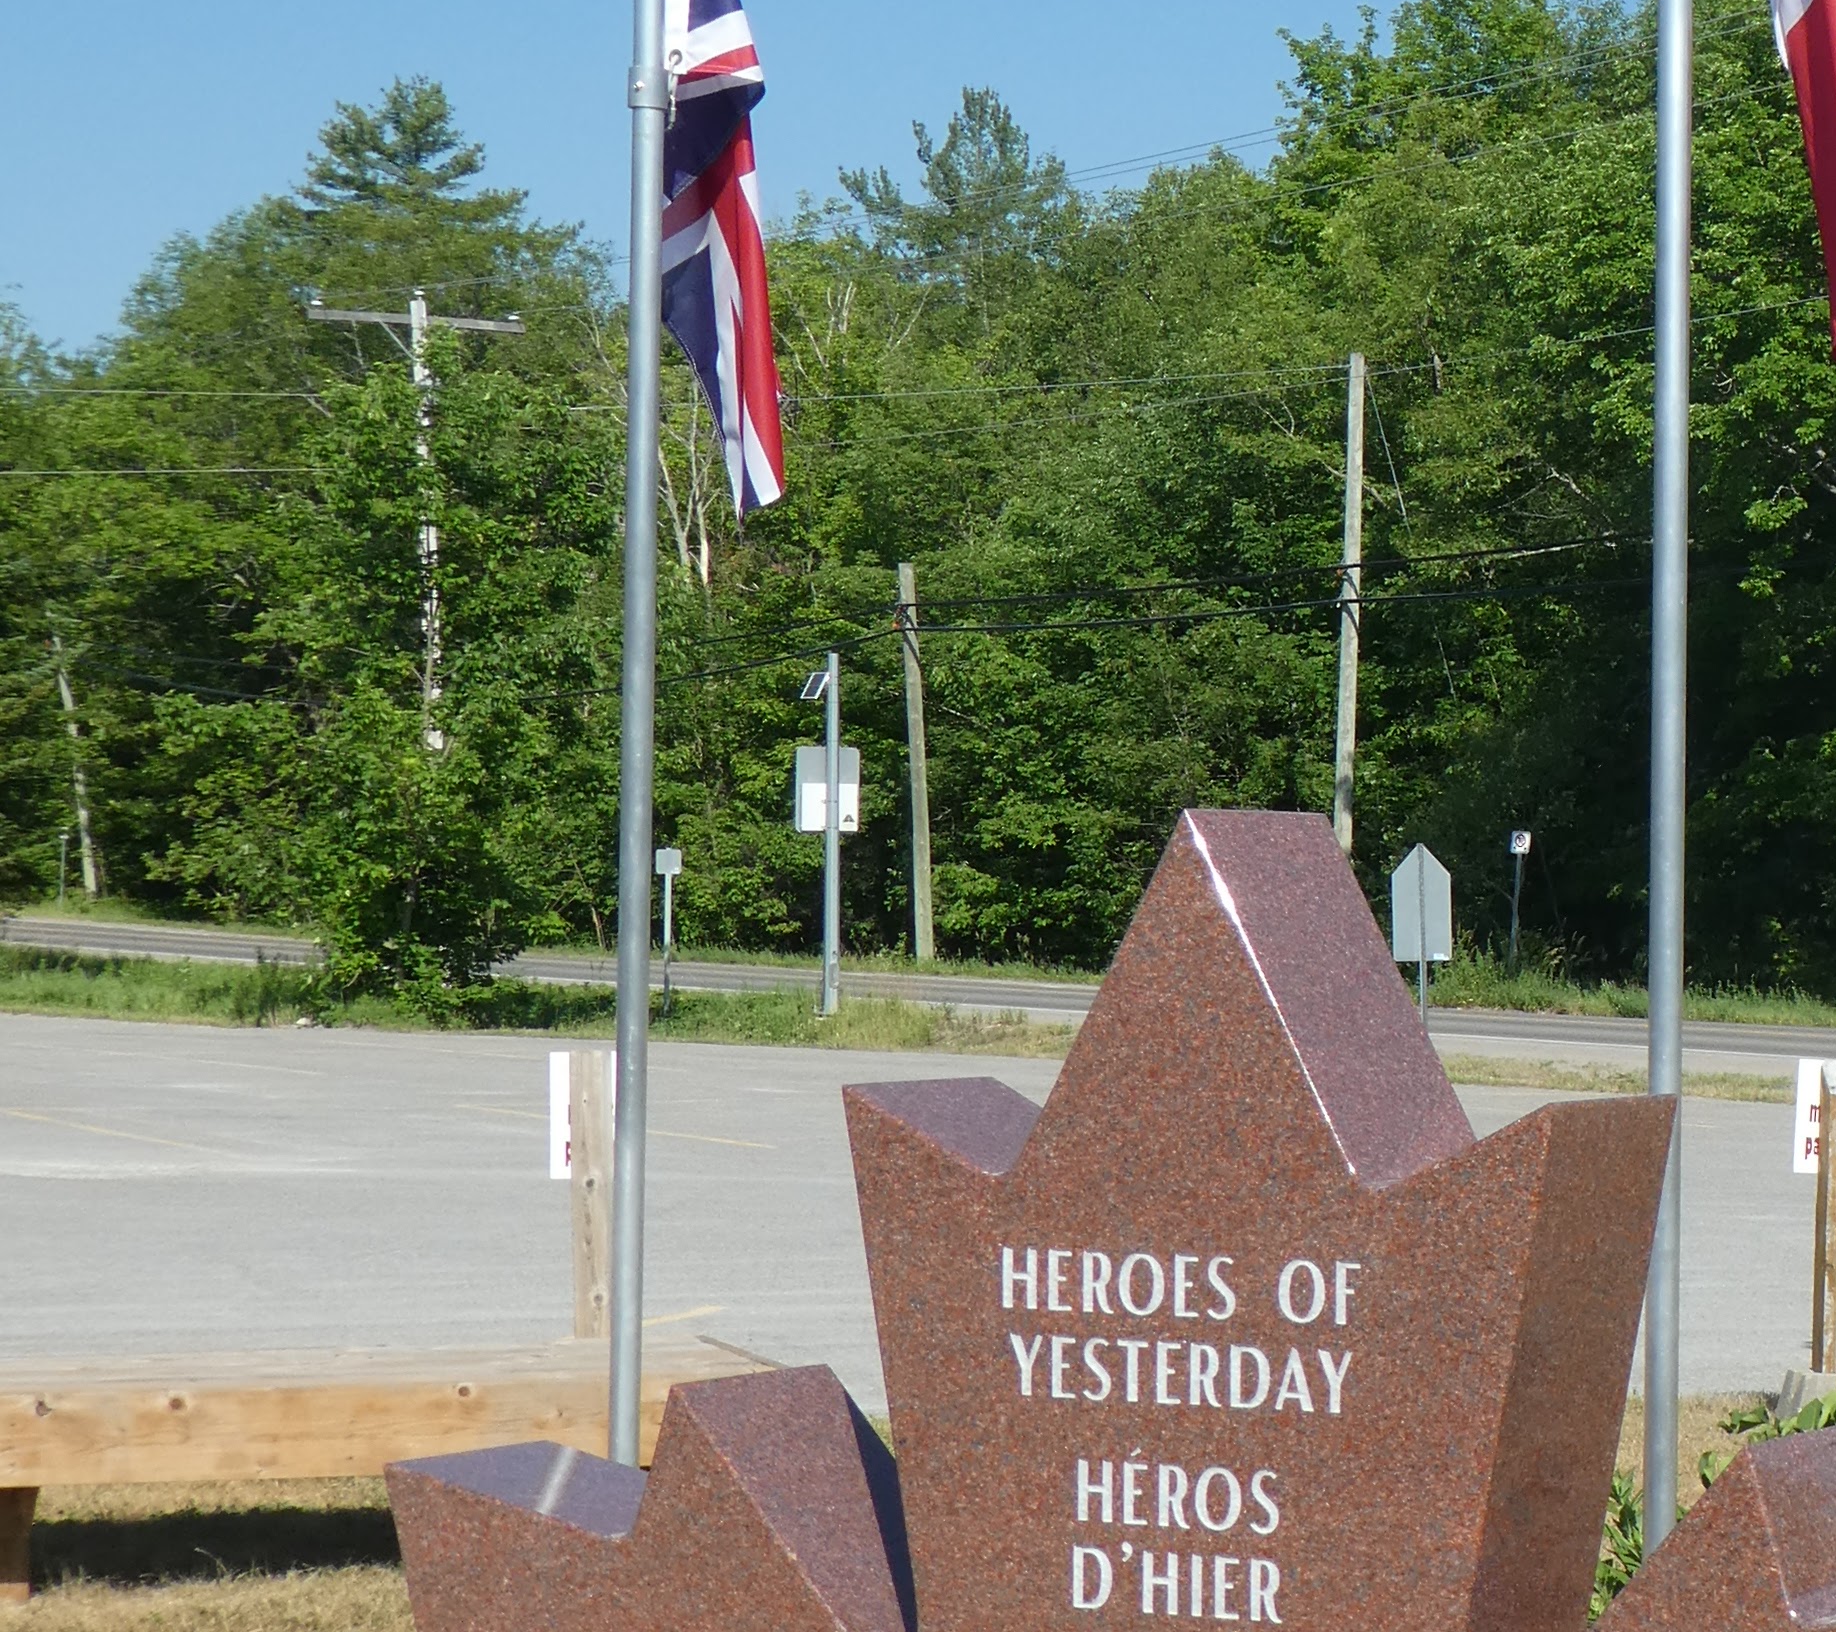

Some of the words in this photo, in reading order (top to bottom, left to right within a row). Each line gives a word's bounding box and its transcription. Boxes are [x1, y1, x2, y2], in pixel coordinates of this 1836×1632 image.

[1000, 1245, 1238, 1322] HEROES
[1276, 1258, 1363, 1327] OF
[1008, 1331, 1354, 1415] YESTERDAY
[1076, 1446, 1281, 1536] HÉROS
